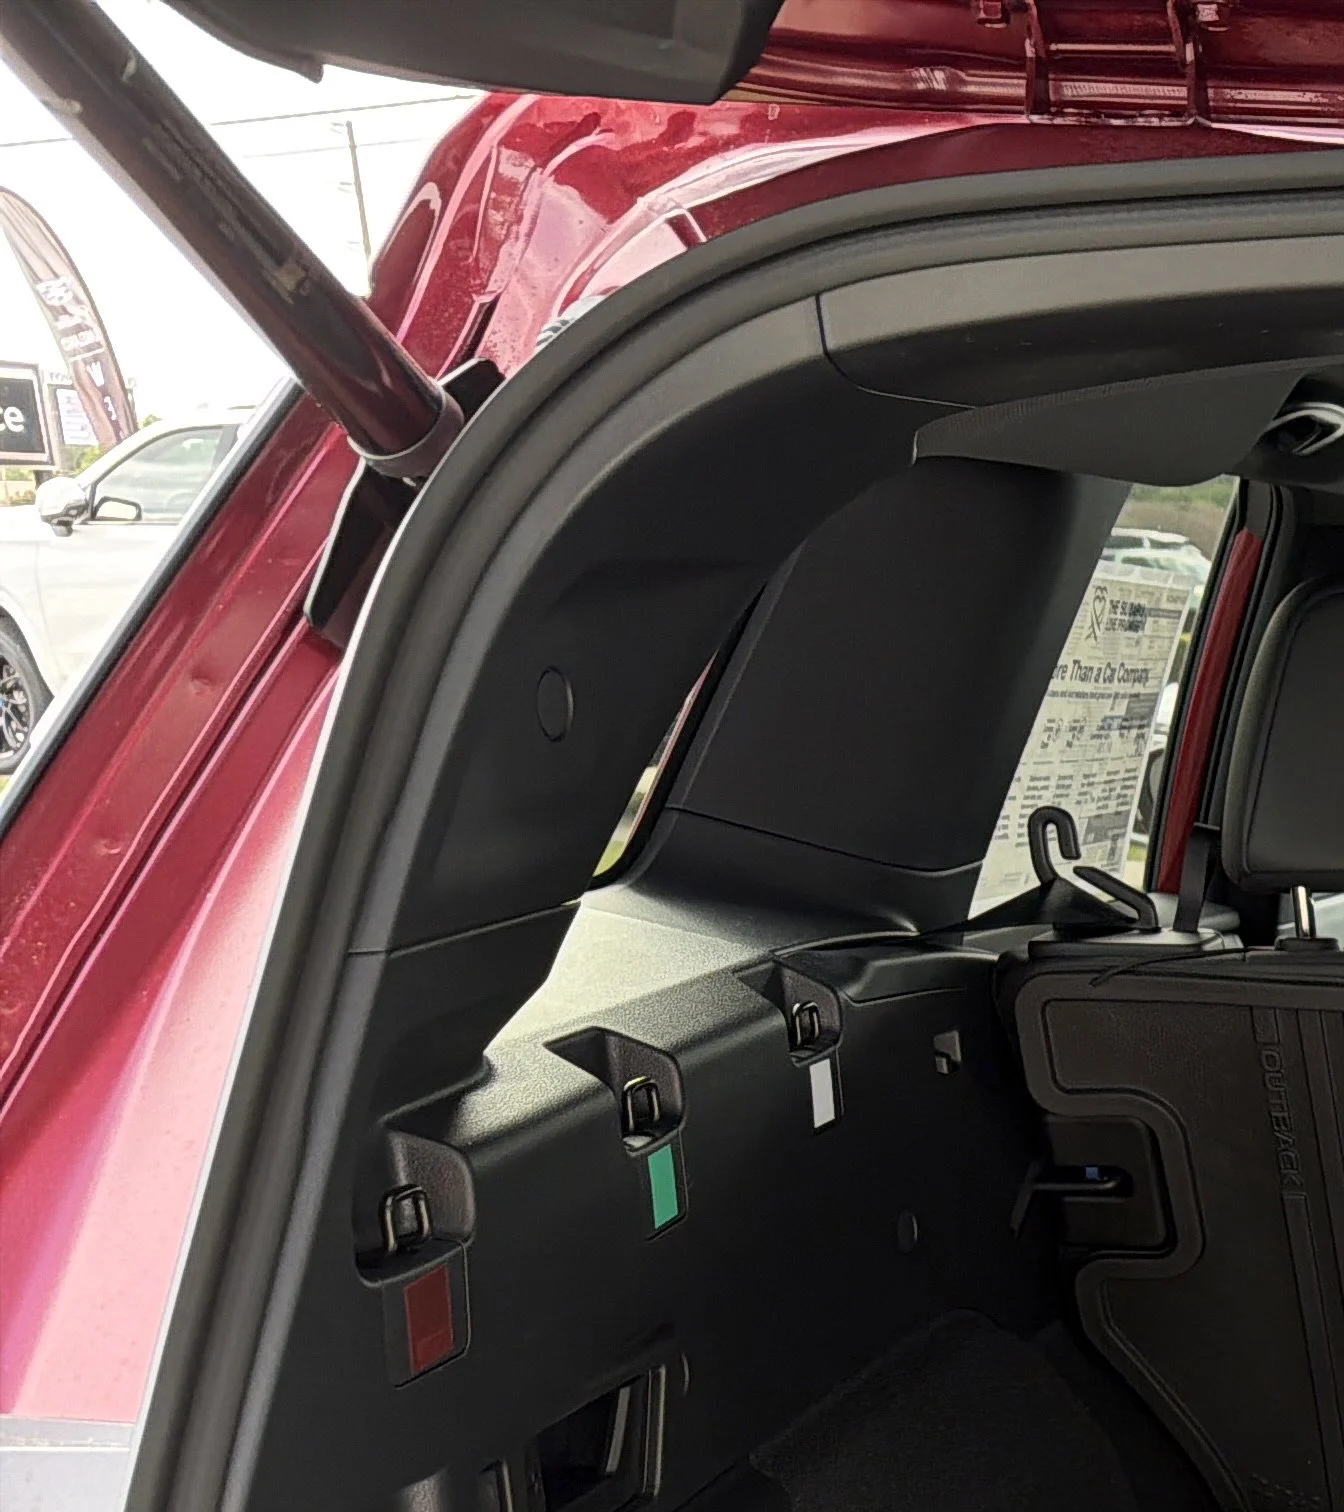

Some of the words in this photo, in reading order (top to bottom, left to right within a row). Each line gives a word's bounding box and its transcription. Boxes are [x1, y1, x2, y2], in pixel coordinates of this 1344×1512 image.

[1052, 663, 1068, 681] ore
[1070, 659, 1094, 681] Than
[1261, 1048, 1303, 1186] OUTBACK
